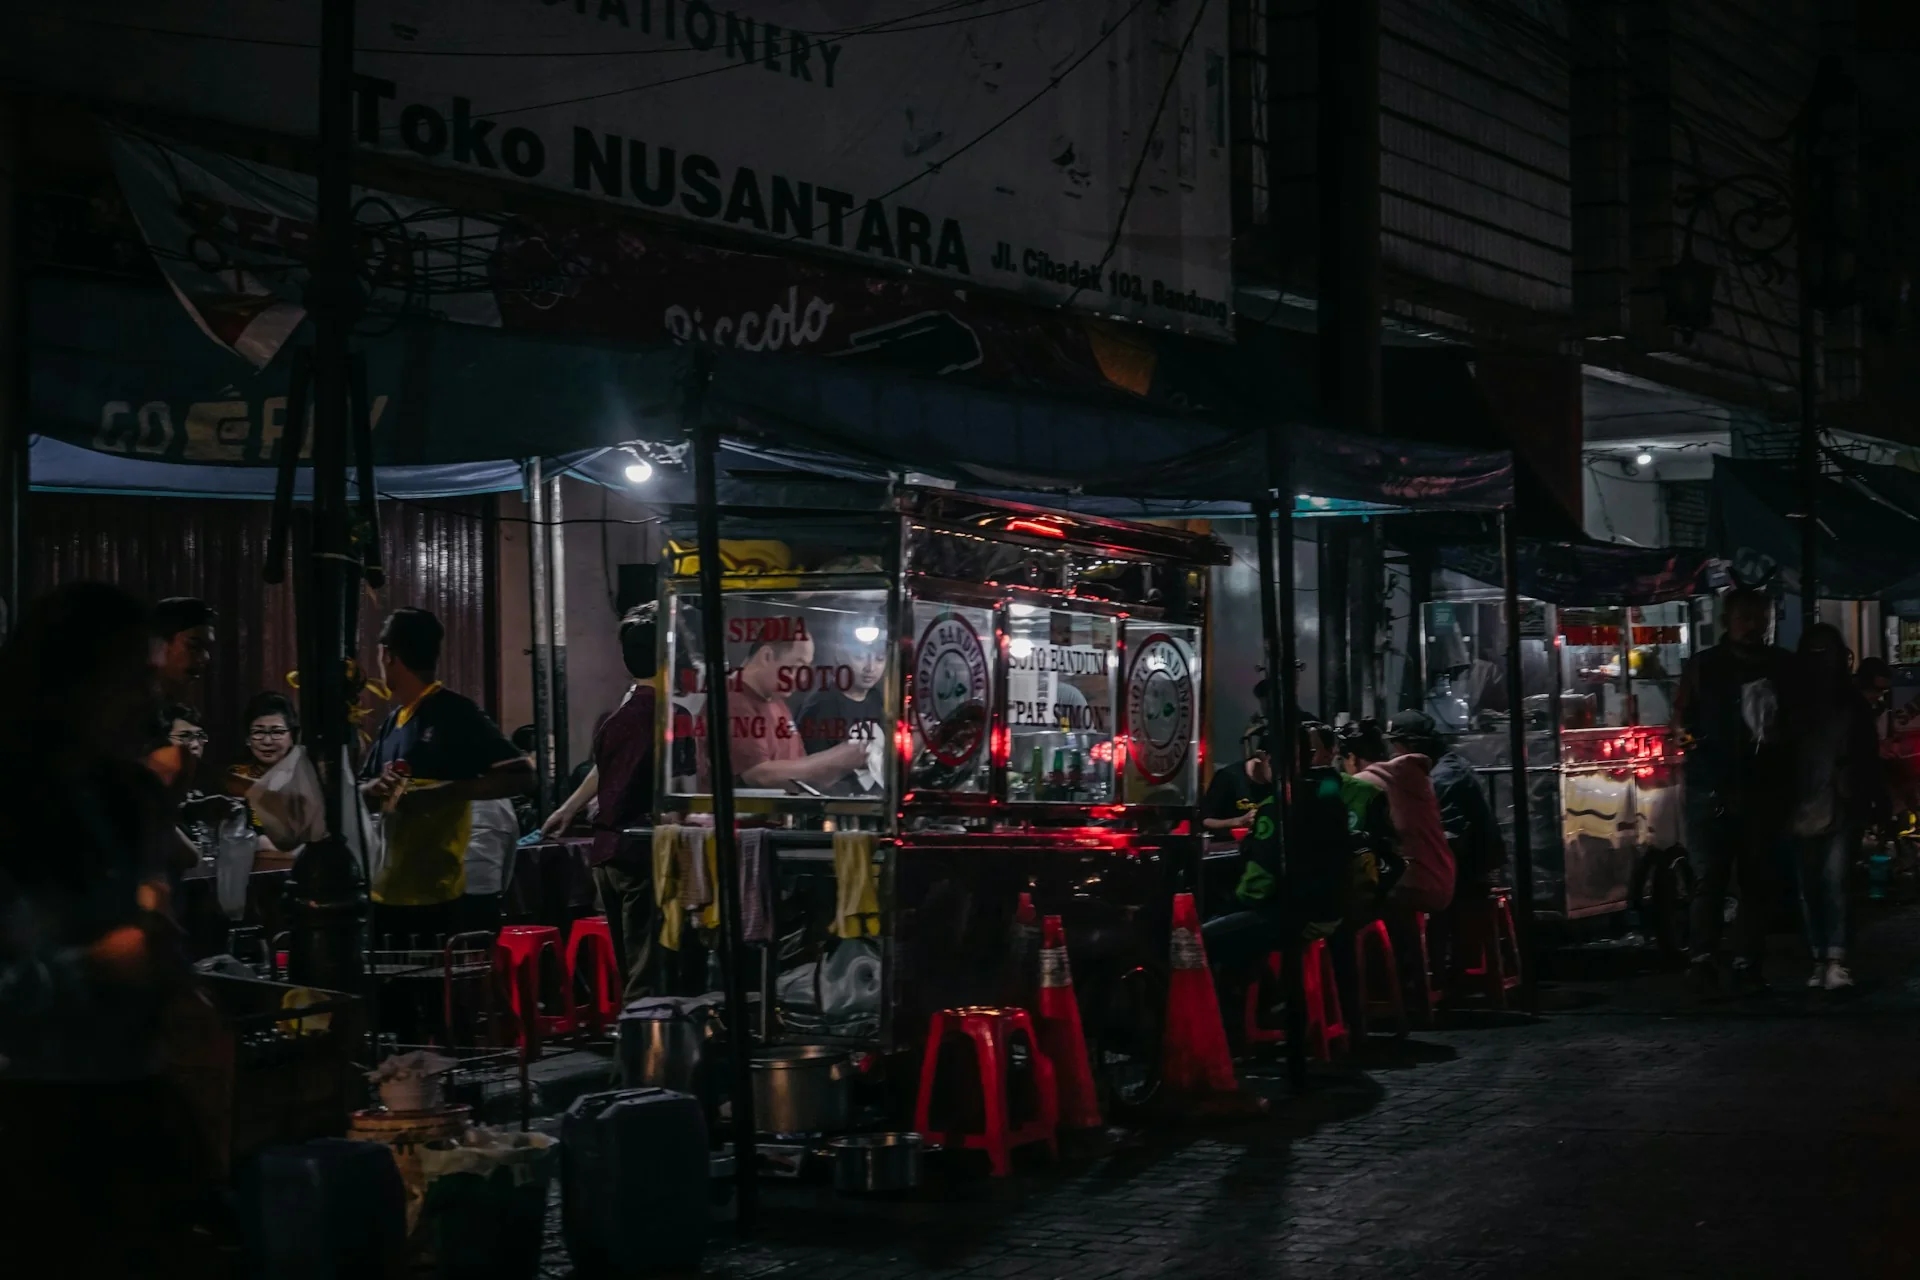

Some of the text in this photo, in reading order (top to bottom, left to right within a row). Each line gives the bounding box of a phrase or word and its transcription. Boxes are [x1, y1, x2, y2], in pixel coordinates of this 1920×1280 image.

[352, 75, 970, 275] Toko NUSANTARA
[1153, 279, 1227, 325] Bandung
[729, 617, 808, 642] SEDIA
[1050, 649, 1109, 676] BANDUN
[778, 665, 854, 692] SOTO
[674, 714, 765, 739] DANG
[776, 716, 792, 739] &
